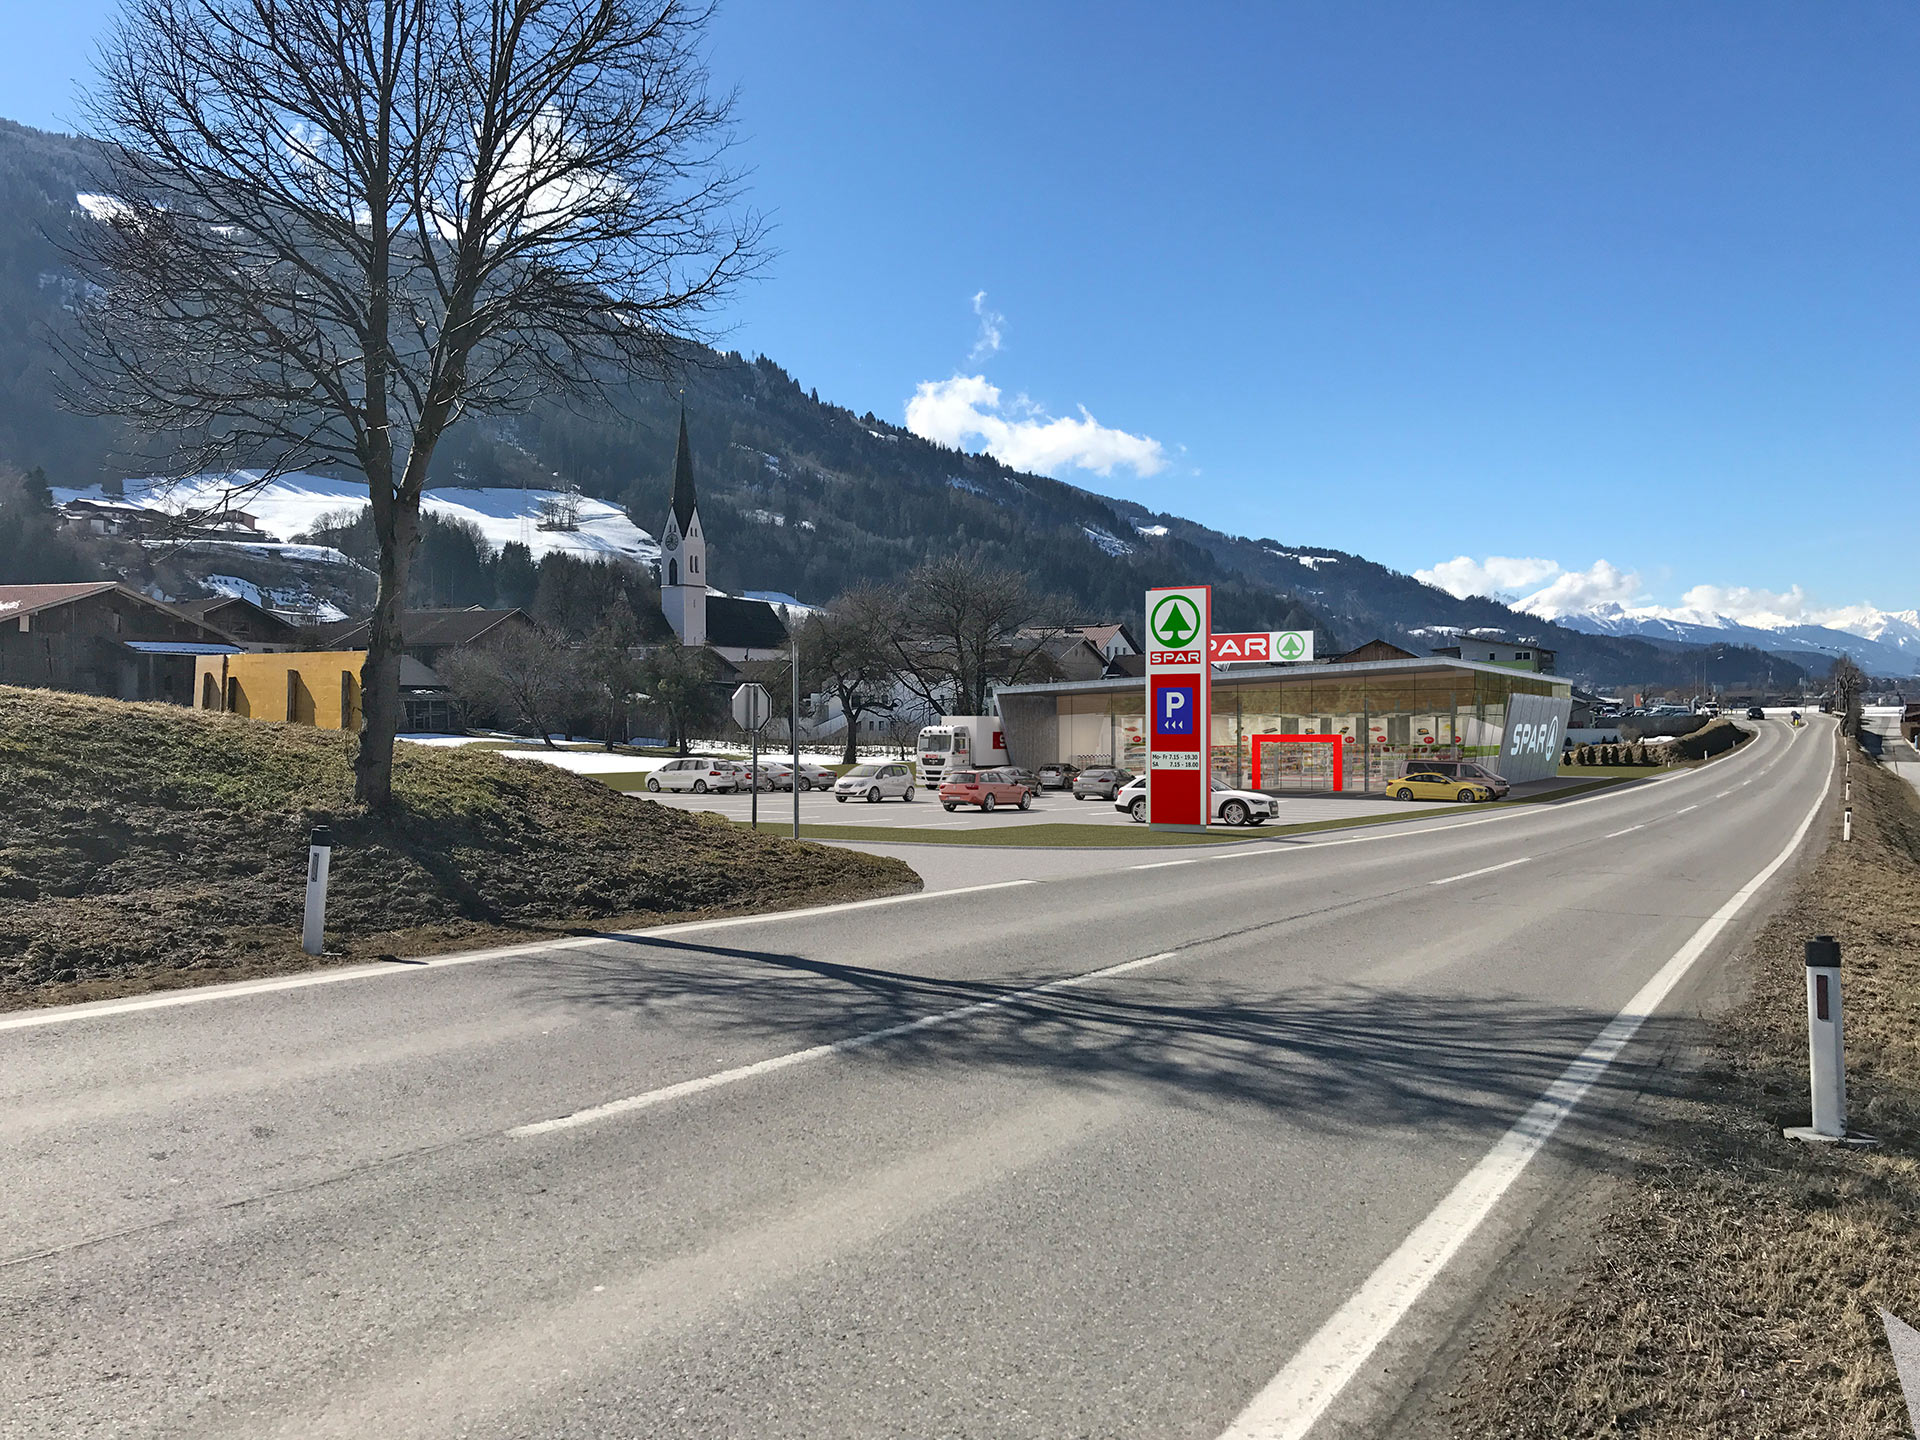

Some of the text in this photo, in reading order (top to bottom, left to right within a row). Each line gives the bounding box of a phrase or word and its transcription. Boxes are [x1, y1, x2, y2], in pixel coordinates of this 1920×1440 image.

[1152, 652, 1199, 663] SPAR
[1211, 638, 1266, 656] AR
[1166, 691, 1185, 718] P
[1510, 723, 1548, 756] SPAR
